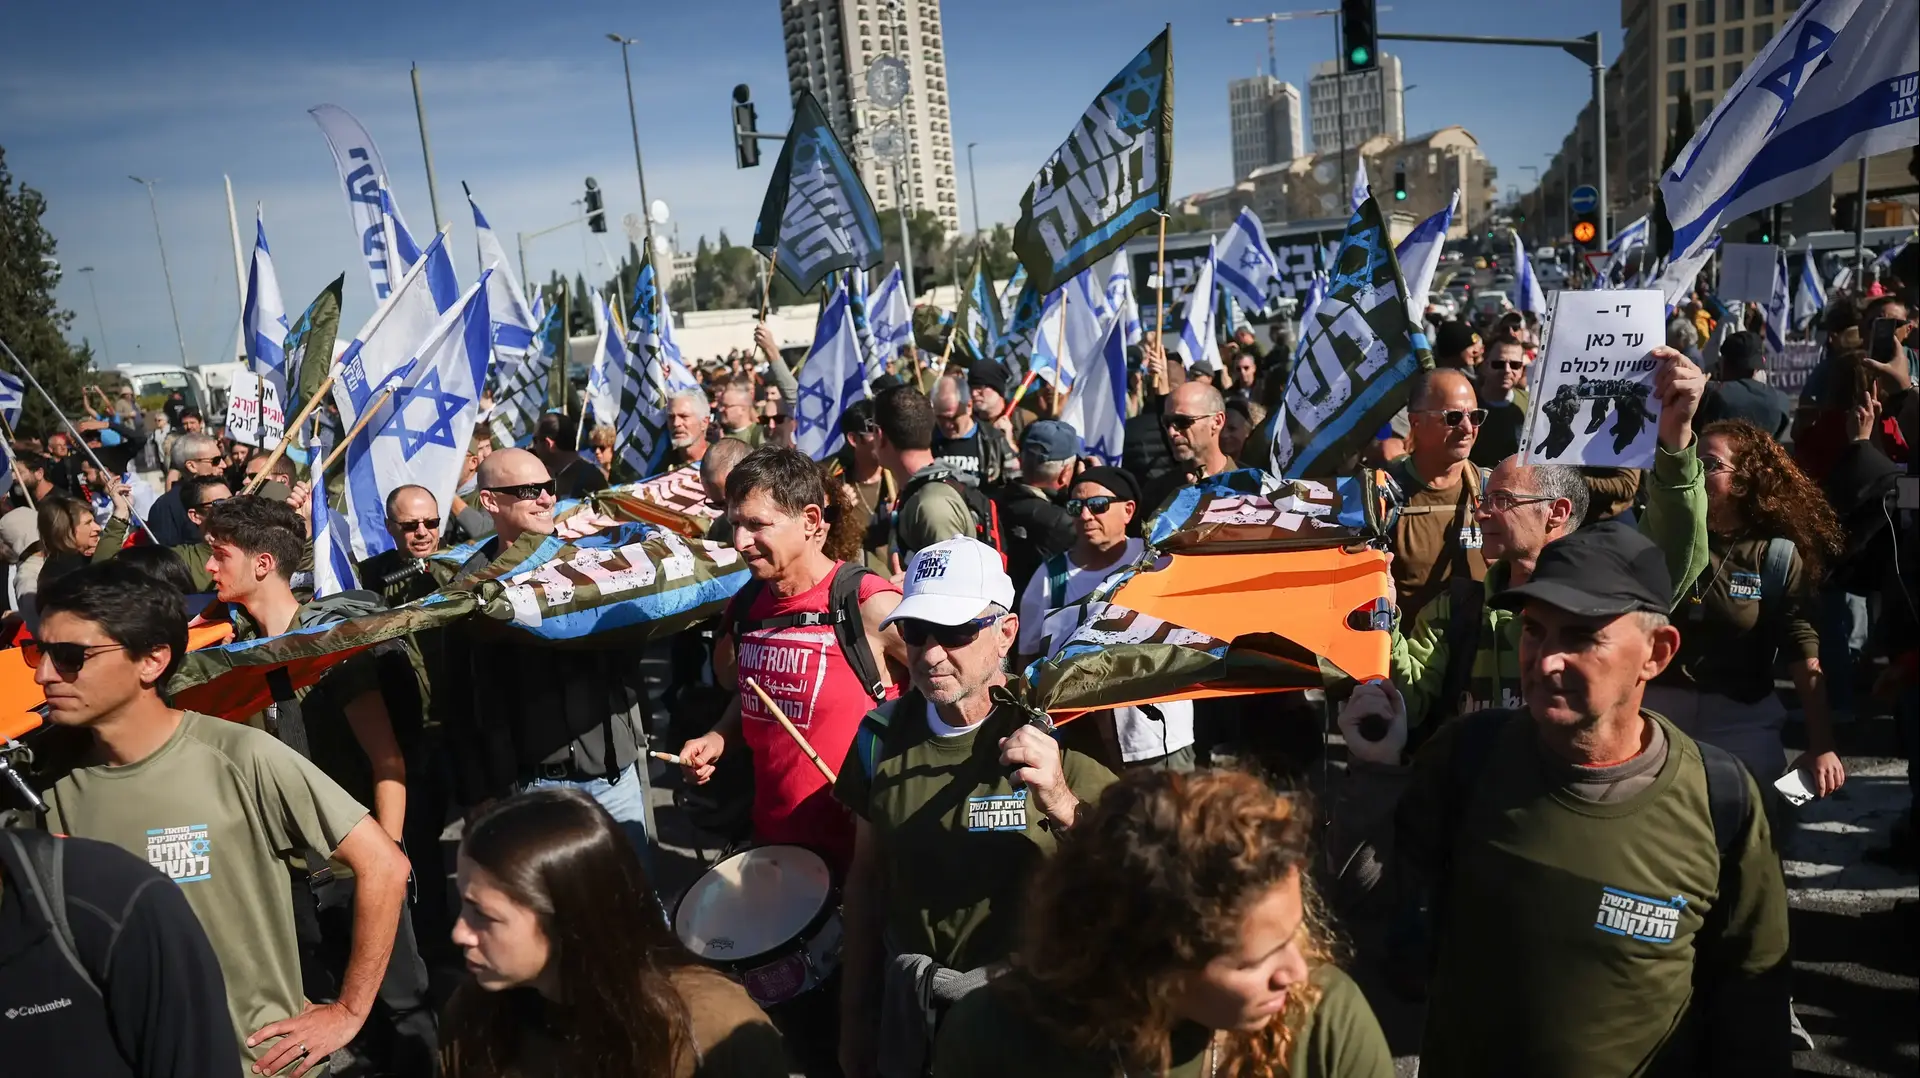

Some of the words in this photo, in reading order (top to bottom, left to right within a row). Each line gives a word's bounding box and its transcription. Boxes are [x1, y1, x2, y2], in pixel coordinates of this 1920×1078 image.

[1615, 304, 1631, 318] די
[1585, 333, 1615, 351] כאן
[1621, 332, 1644, 347] עד
[1560, 357, 1607, 373] לכולם
[1613, 359, 1658, 376] שוויון
[764, 698, 803, 719] החזת
[969, 801, 989, 813] לנשק
[968, 809, 1027, 829] התקווה
[147, 840, 195, 863] אחים
[1600, 892, 1635, 911] לנשק
[1596, 904, 1679, 939] התקווה
[18, 997, 73, 1016] Columbia
